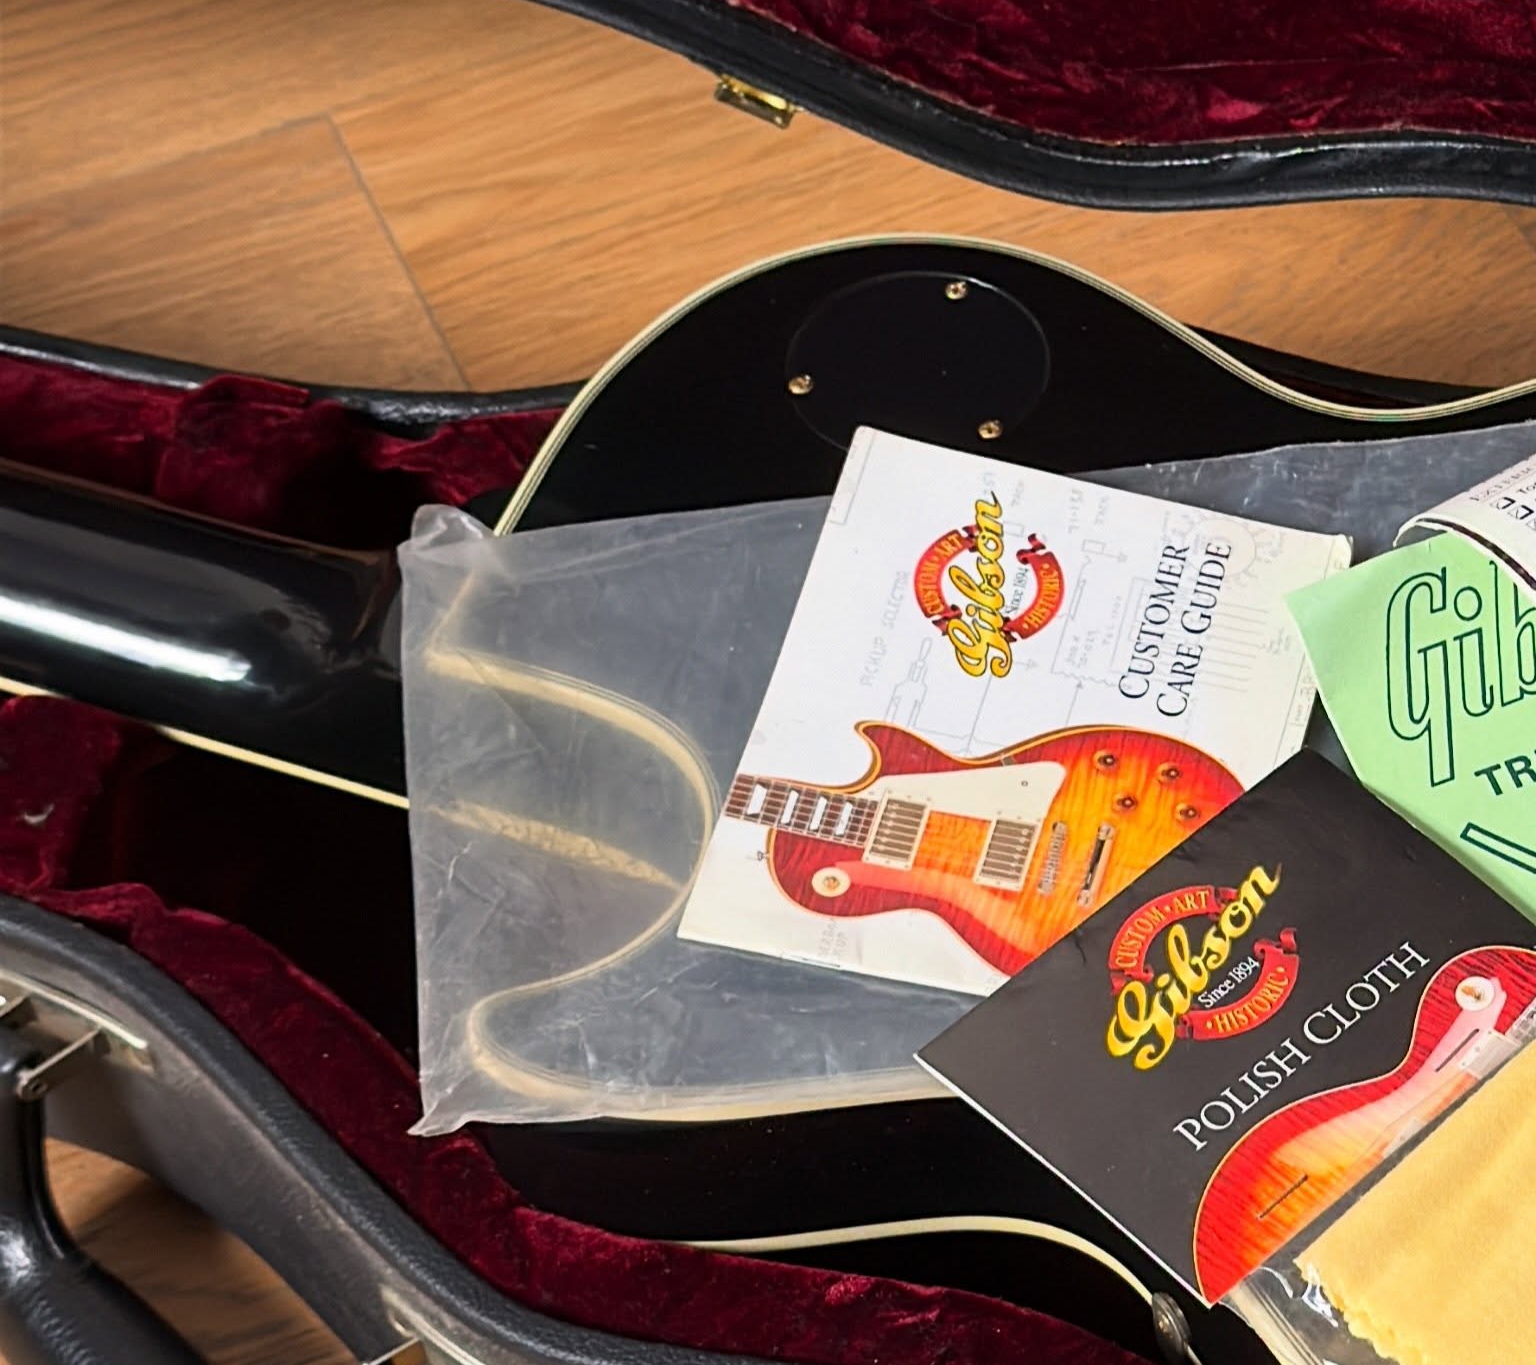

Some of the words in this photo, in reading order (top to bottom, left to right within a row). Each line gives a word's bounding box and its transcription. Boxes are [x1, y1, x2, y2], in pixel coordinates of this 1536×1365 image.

[946, 490, 1013, 678] Gibson
[1005, 588, 1024, 615] Since
[1119, 542, 1190, 699] CUSTOMER
[1157, 643, 1204, 718] CARE
[1181, 539, 1232, 634] GUIDE
[1106, 862, 1283, 1070] Gibson
[1115, 905, 1166, 968] CUSTOM
[1172, 890, 1210, 915] ART
[1198, 979, 1235, 1009] Since
[1233, 955, 1260, 984] 1894
[1213, 971, 1289, 1034] HISTORIC
[1173, 1037, 1312, 1151] POLISH
[1302, 941, 1430, 1045] CLOTH
